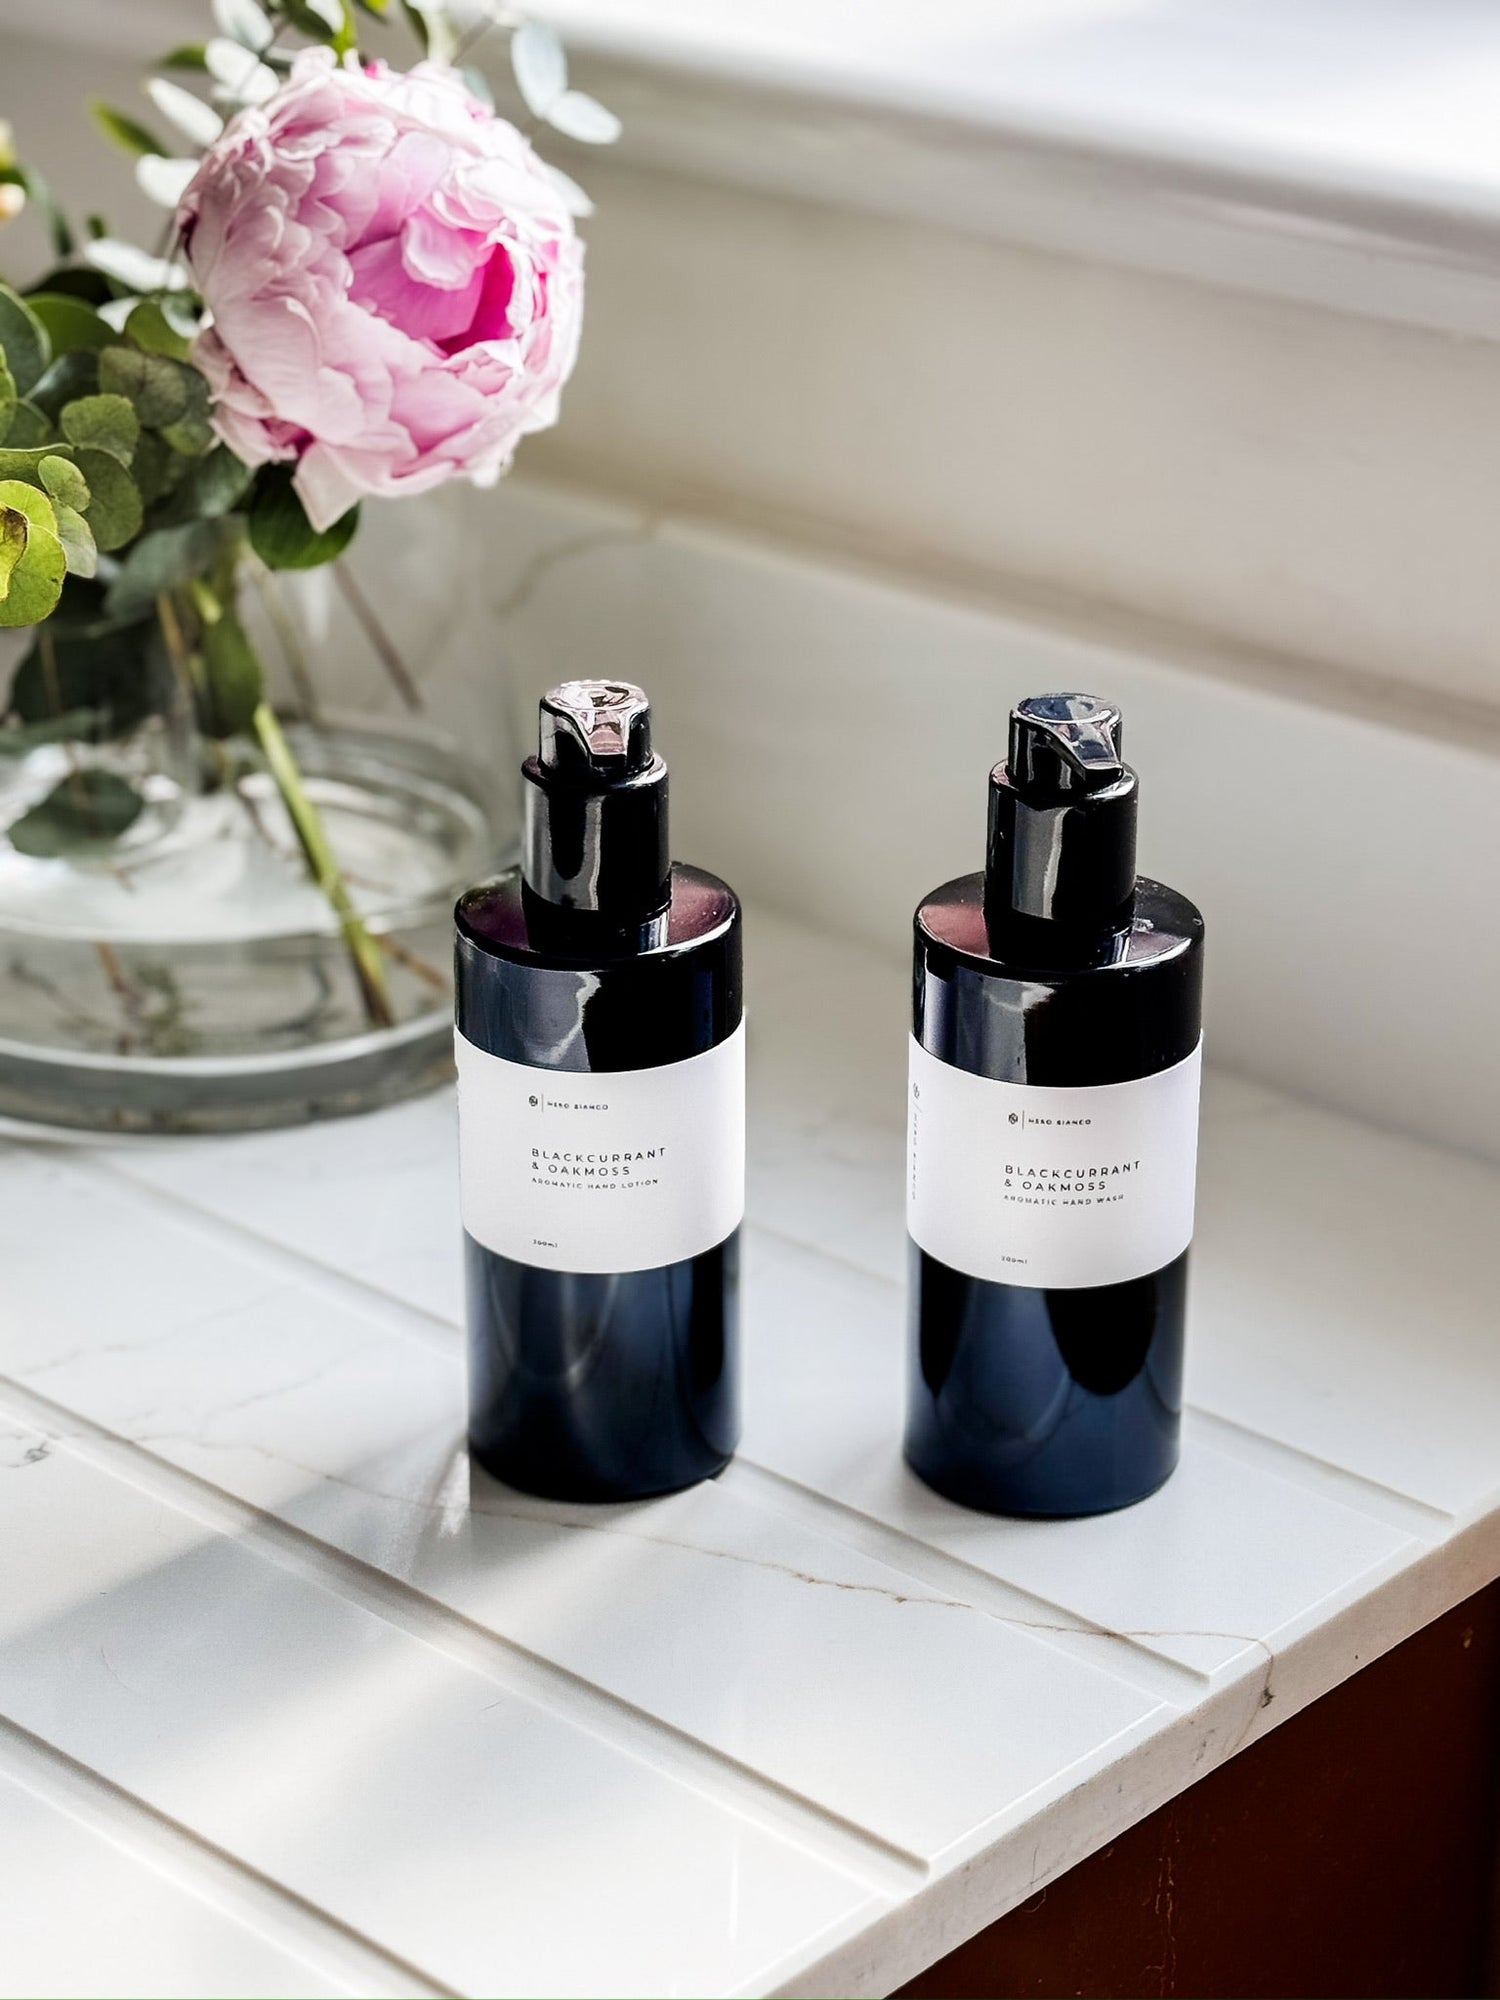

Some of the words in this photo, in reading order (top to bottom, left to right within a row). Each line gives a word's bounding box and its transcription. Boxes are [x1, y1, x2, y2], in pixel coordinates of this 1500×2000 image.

[532, 1147, 666, 1163] BLACKCURRANT
[532, 1162, 539, 1170] &
[548, 1164, 630, 1177] OAKMOSS
[1005, 1161, 1140, 1179] BLACKCURRANT
[532, 1177, 583, 1189] AROMATIC
[621, 1178, 658, 1189] LOTION
[1004, 1179, 1012, 1187] &
[1022, 1181, 1106, 1192] OAKMOSS
[1004, 1195, 1057, 1206] AROMATIC
[1062, 1198, 1091, 1206] HAND
[1096, 1195, 1124, 1203] WASH
